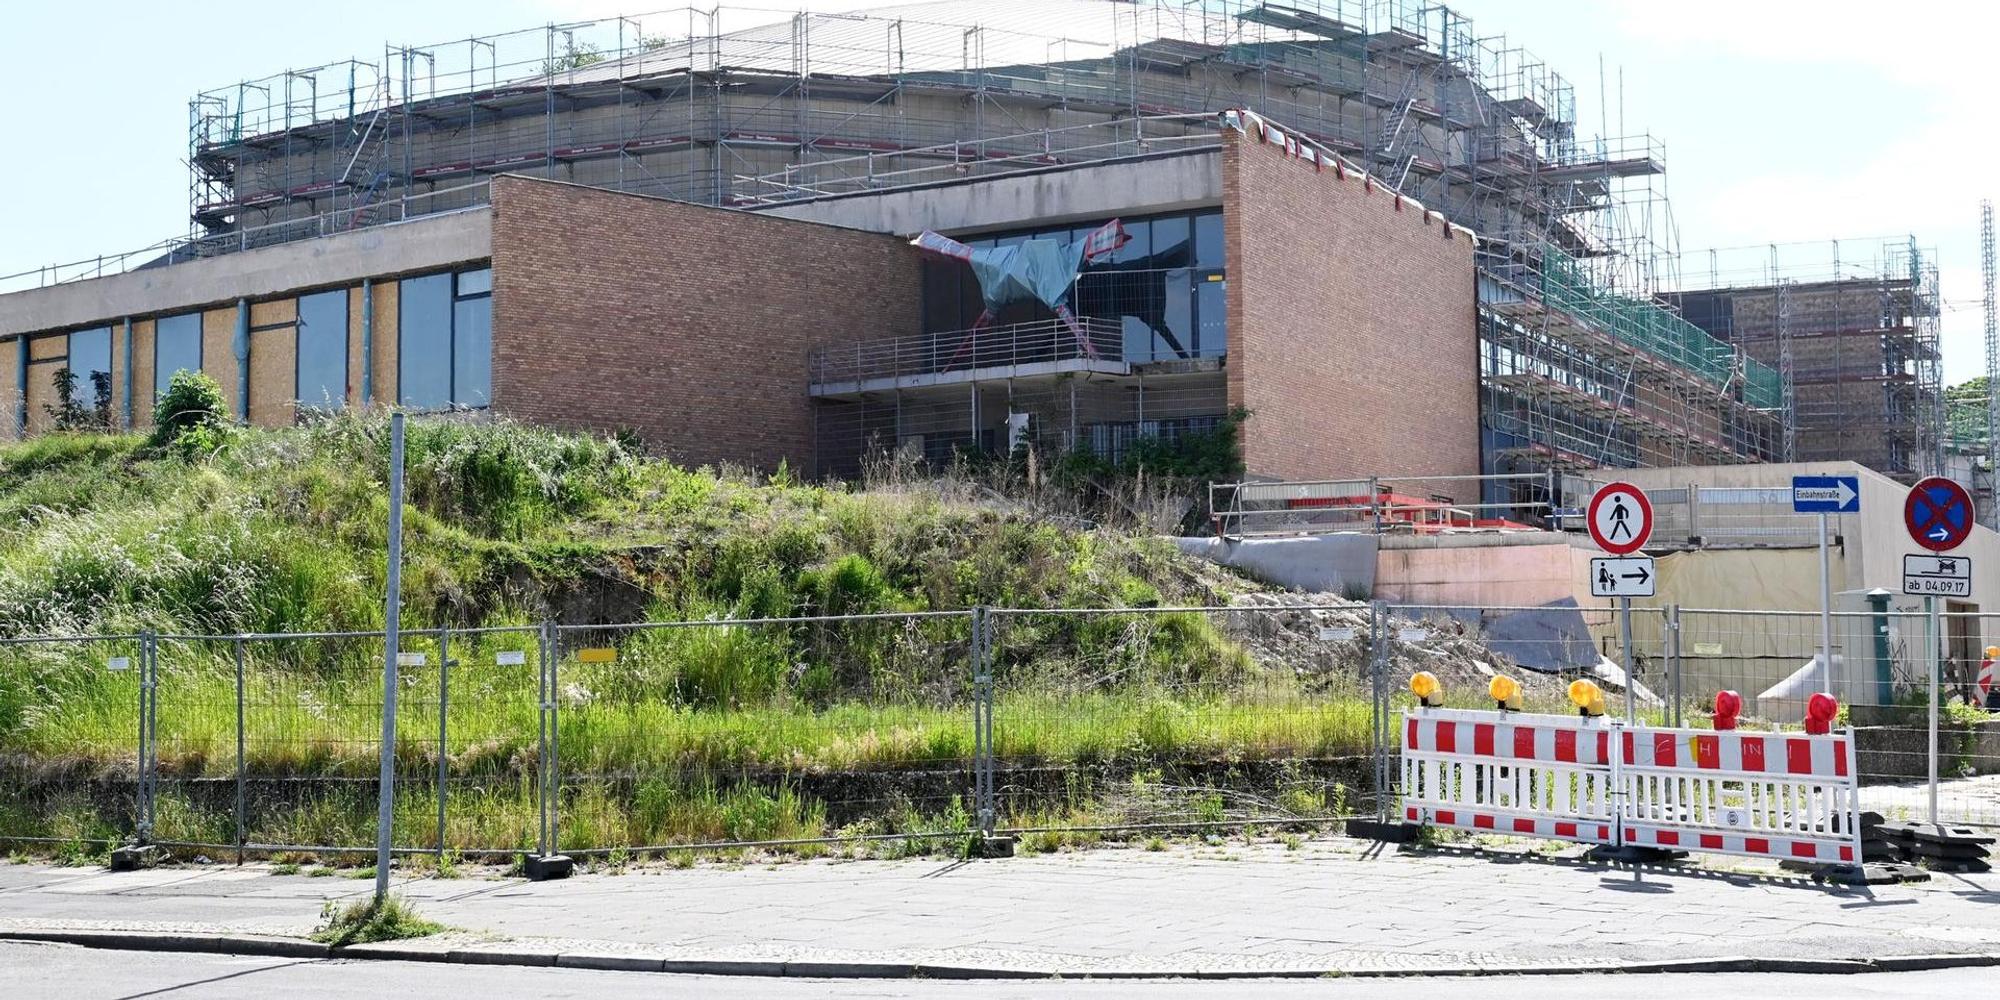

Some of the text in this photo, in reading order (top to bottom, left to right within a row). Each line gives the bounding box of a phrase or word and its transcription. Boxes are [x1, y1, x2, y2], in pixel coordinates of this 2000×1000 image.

[1796, 489, 1840, 499] Einbahnstraße
[1908, 580, 1964, 592] ab 04.09.17
